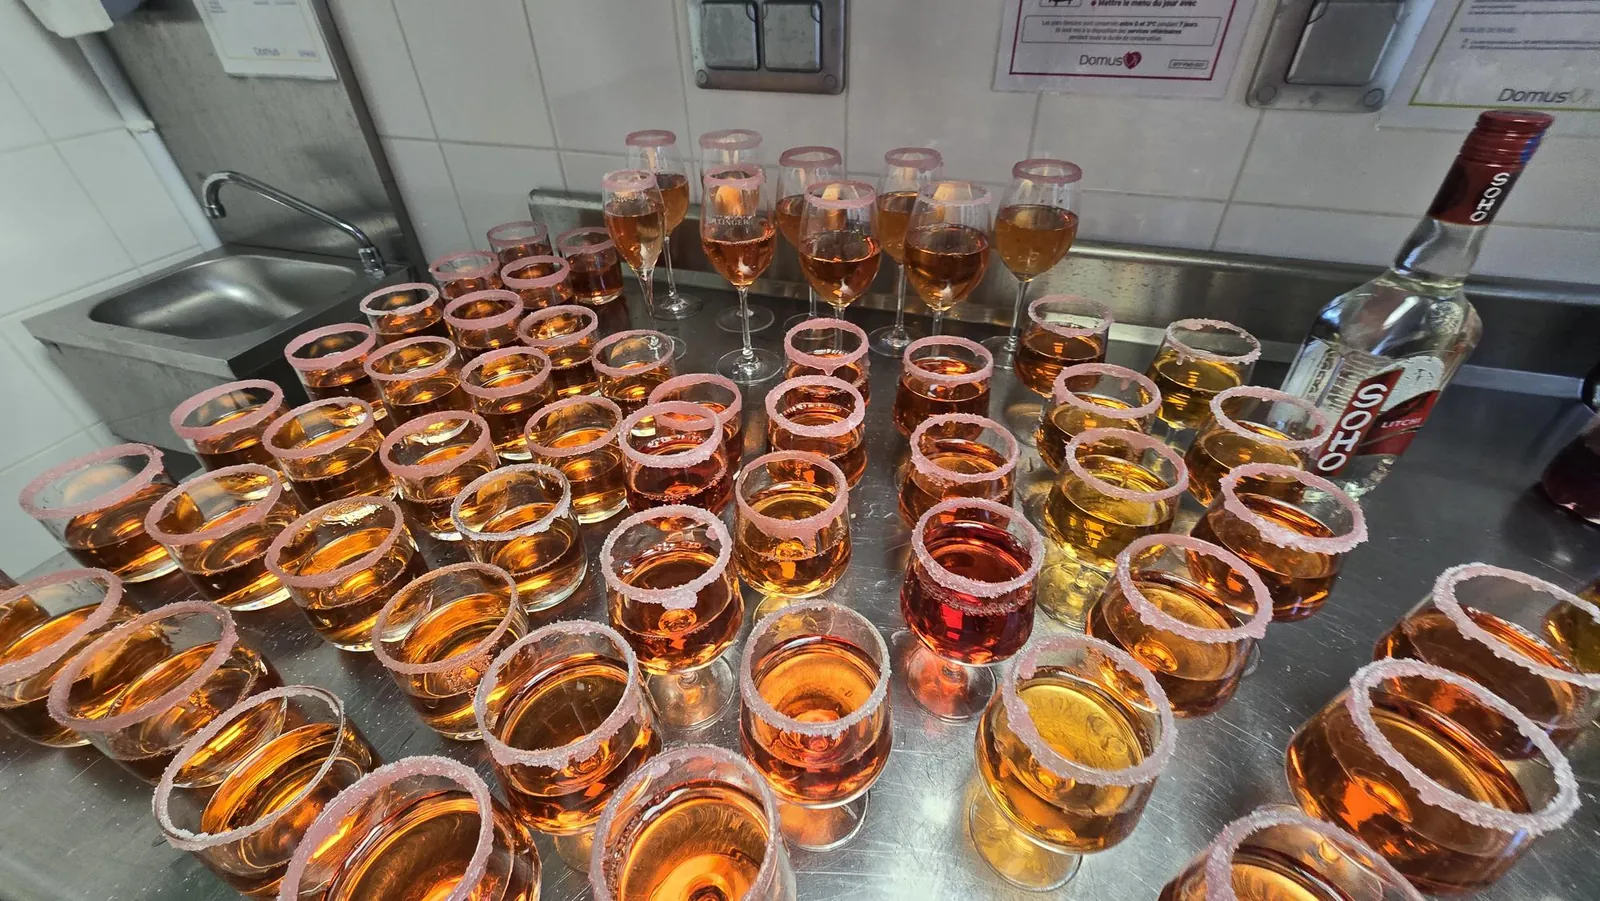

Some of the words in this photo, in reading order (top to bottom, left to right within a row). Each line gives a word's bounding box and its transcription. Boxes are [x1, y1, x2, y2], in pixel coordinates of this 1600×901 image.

[1162, 0, 1179, 8] jour
[1079, 54, 1123, 66] Domus
[1497, 88, 1570, 103] Domus
[1469, 172, 1510, 222] SOHO
[1317, 383, 1388, 471] SOHO
[1380, 417, 1423, 429] LITCHI
